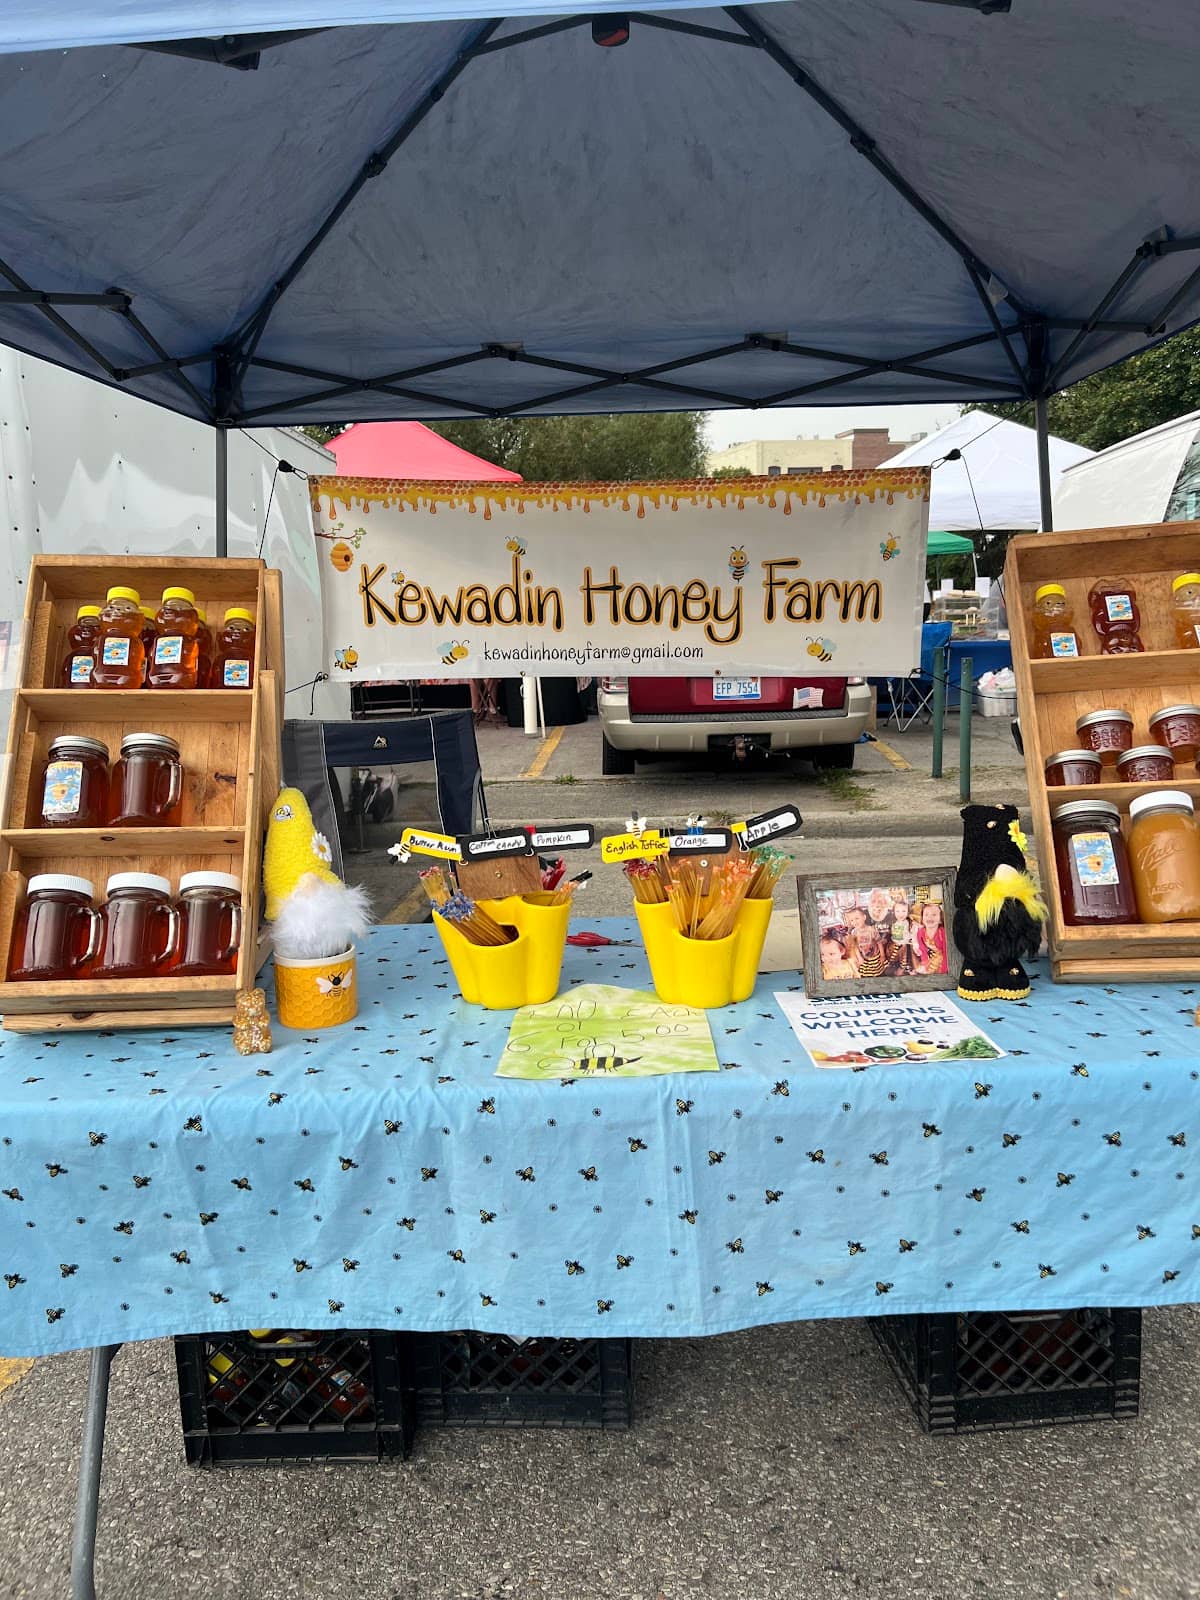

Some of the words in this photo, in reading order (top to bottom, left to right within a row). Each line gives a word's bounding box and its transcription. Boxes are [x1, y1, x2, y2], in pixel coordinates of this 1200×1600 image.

[359, 554, 565, 632] Kewadin
[580, 566, 743, 645] Honey
[761, 557, 884, 623] Farm
[484, 640, 704, 665] kewadinhoneyfarm@gmail.com
[716, 682, 732, 695] EFP
[737, 681, 758, 694] 7554
[747, 822, 780, 841] Apple
[409, 836, 436, 849] Butter
[437, 841, 457, 853] Rum
[536, 834, 574, 846] Pumpkin
[605, 842, 640, 854] English
[641, 839, 669, 850] Toffee
[674, 836, 710, 848] Orange
[800, 1006, 946, 1020] COUPONS
[802, 1016, 958, 1030] WELCOME
[847, 1027, 930, 1039] HERE
